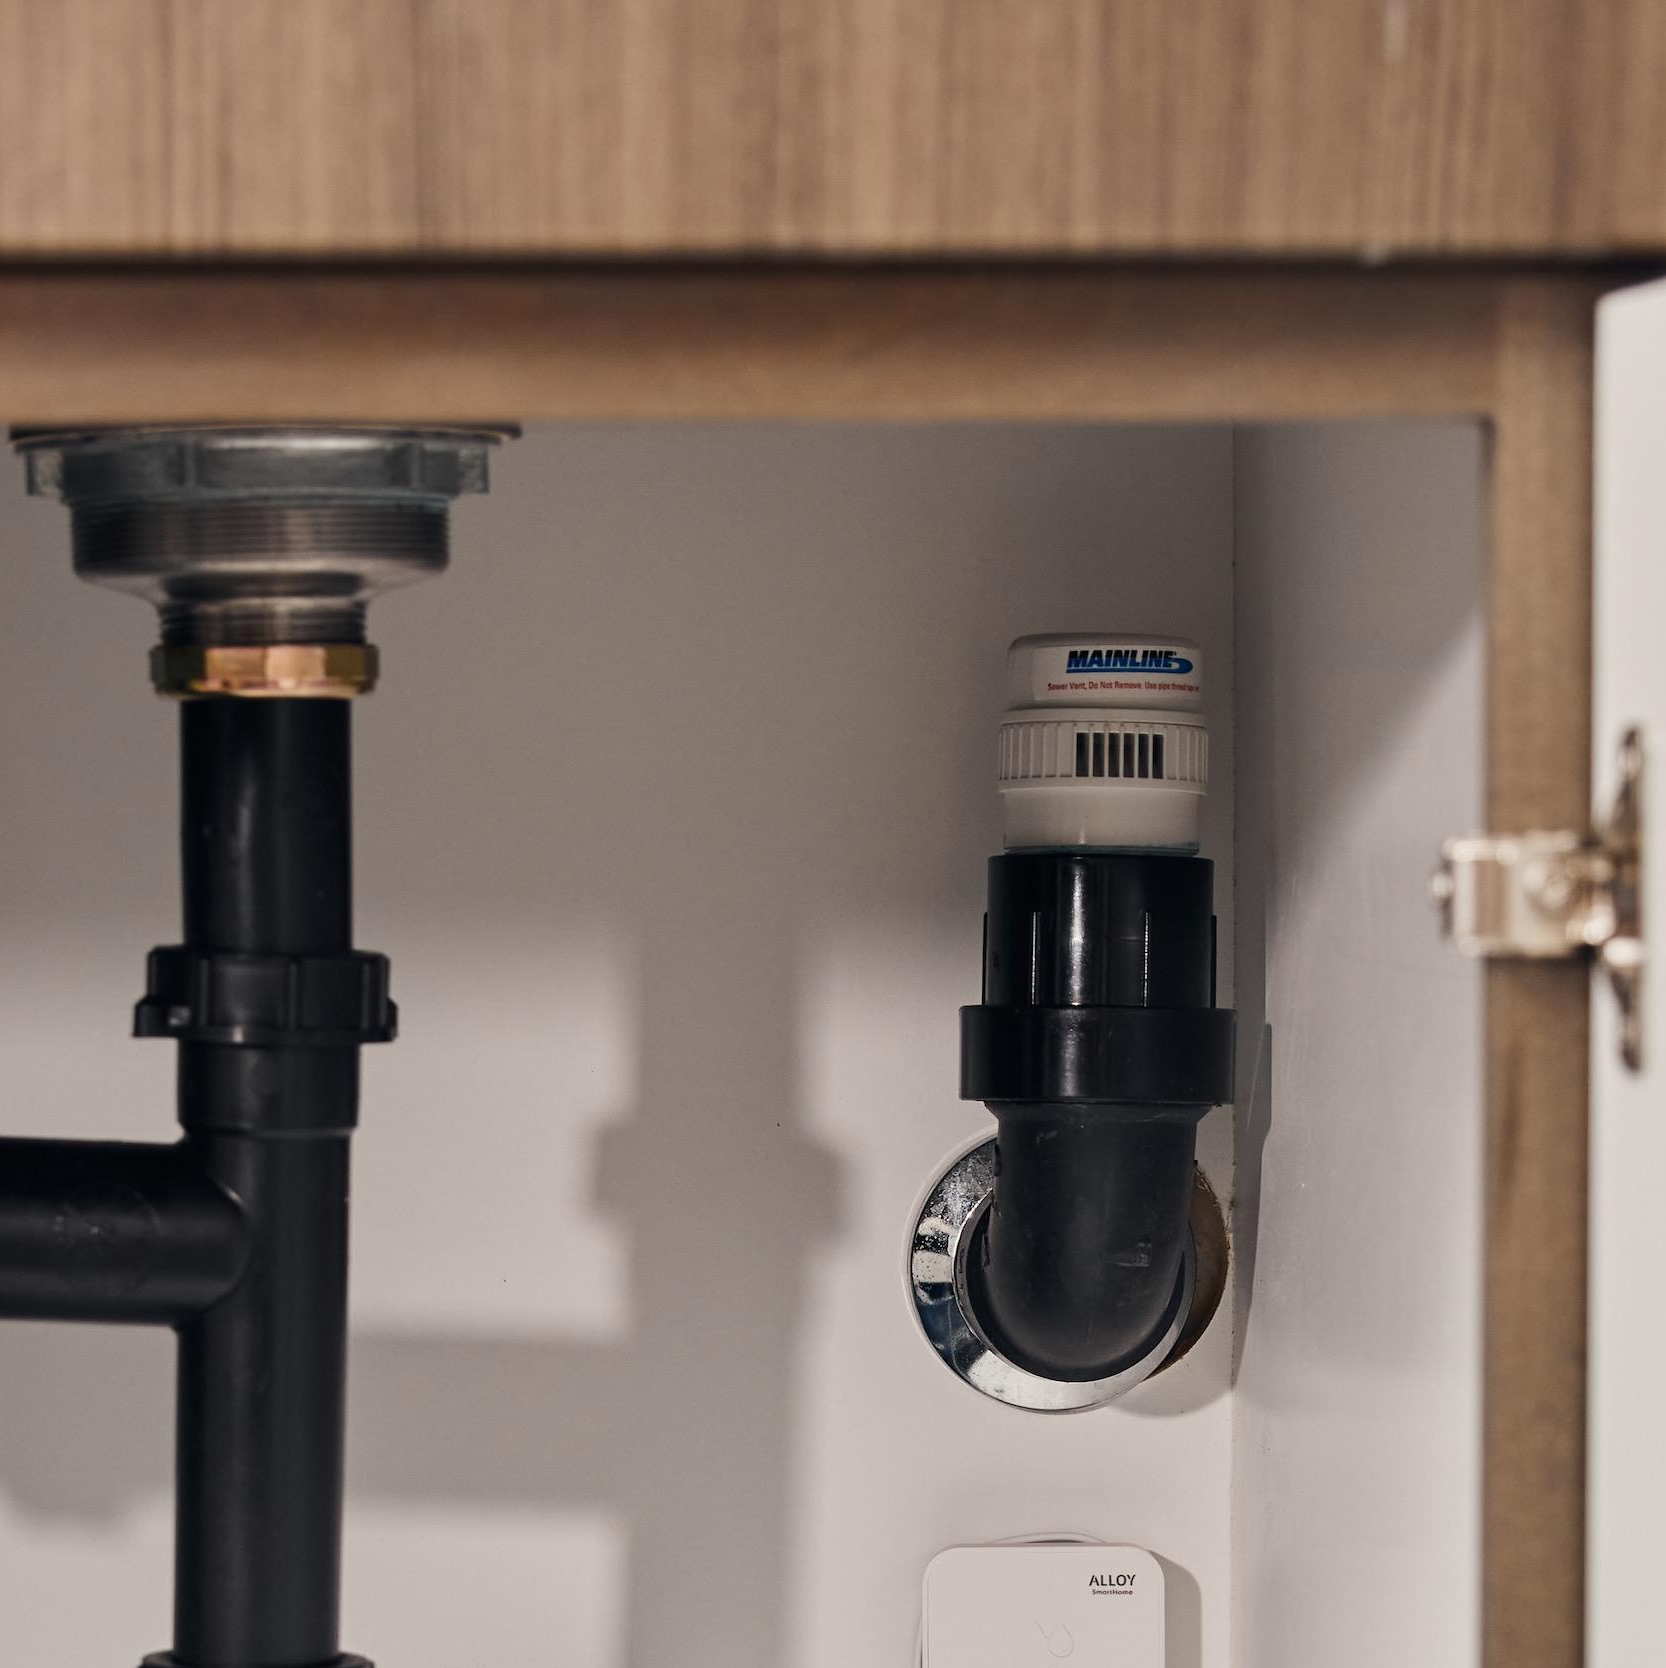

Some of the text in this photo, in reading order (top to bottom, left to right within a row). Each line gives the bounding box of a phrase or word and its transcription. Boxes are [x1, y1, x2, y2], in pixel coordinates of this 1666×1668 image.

[1066, 650, 1178, 669] MAINLINE
[1047, 682, 1068, 691] Sewer
[1088, 681, 1099, 689] Do
[1100, 681, 1113, 689] Not
[1145, 681, 1157, 689] Use
[1089, 1574, 1136, 1586] ALLOY
